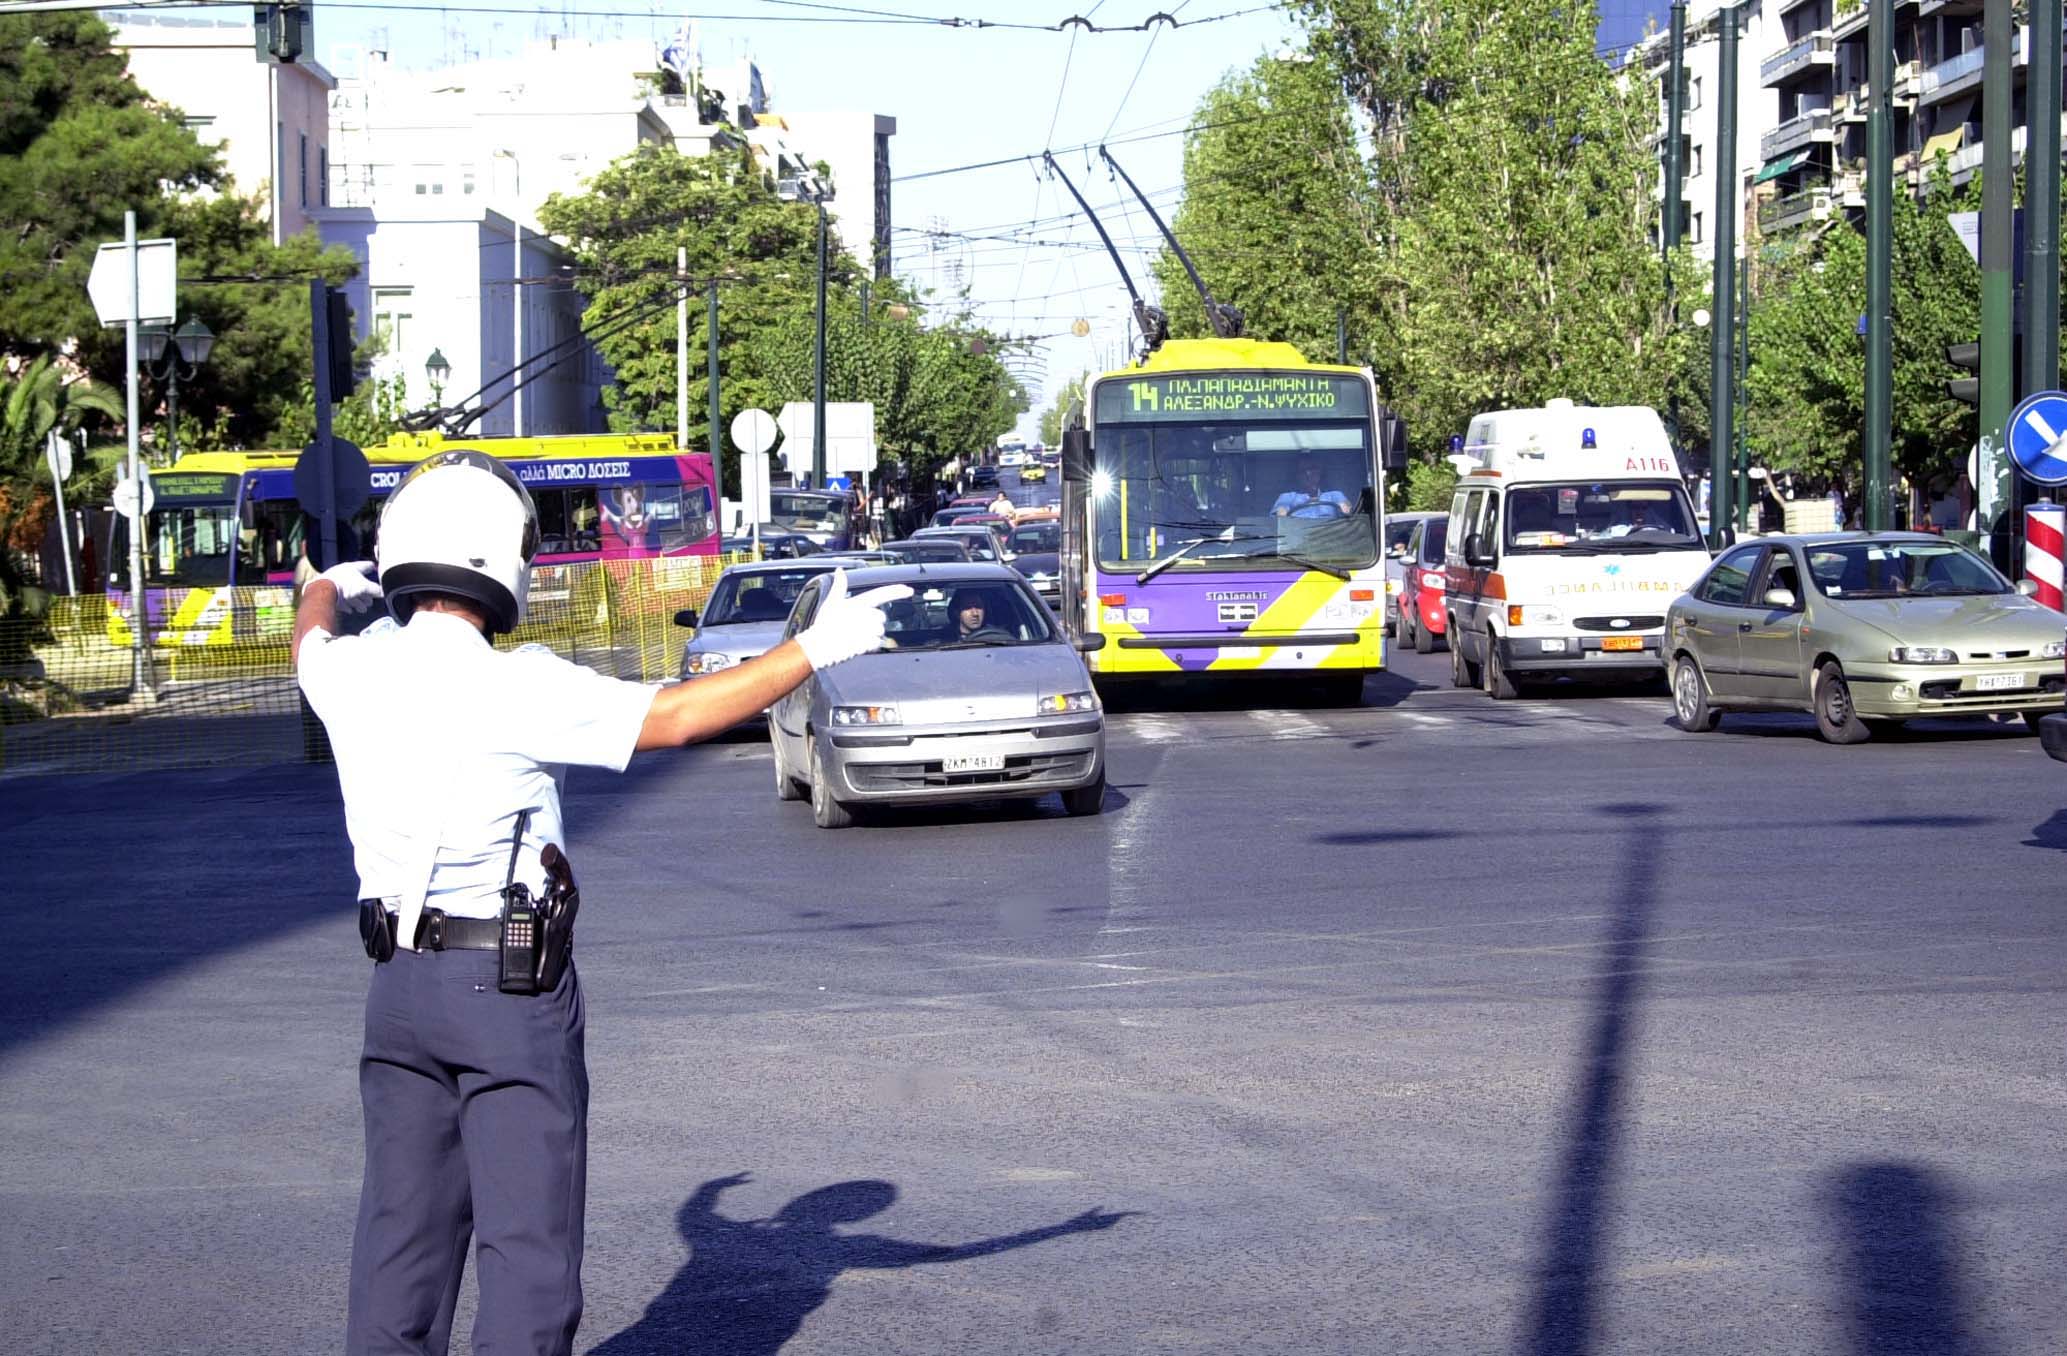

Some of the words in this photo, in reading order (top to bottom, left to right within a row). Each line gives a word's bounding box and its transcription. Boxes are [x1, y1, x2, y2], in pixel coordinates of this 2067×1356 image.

[1128, 382, 1158, 411] 14
[546, 463, 587, 480] MICRO
[587, 461, 632, 479] ΔΟΣΕΙΣ
[1626, 456, 1670, 472] A116
